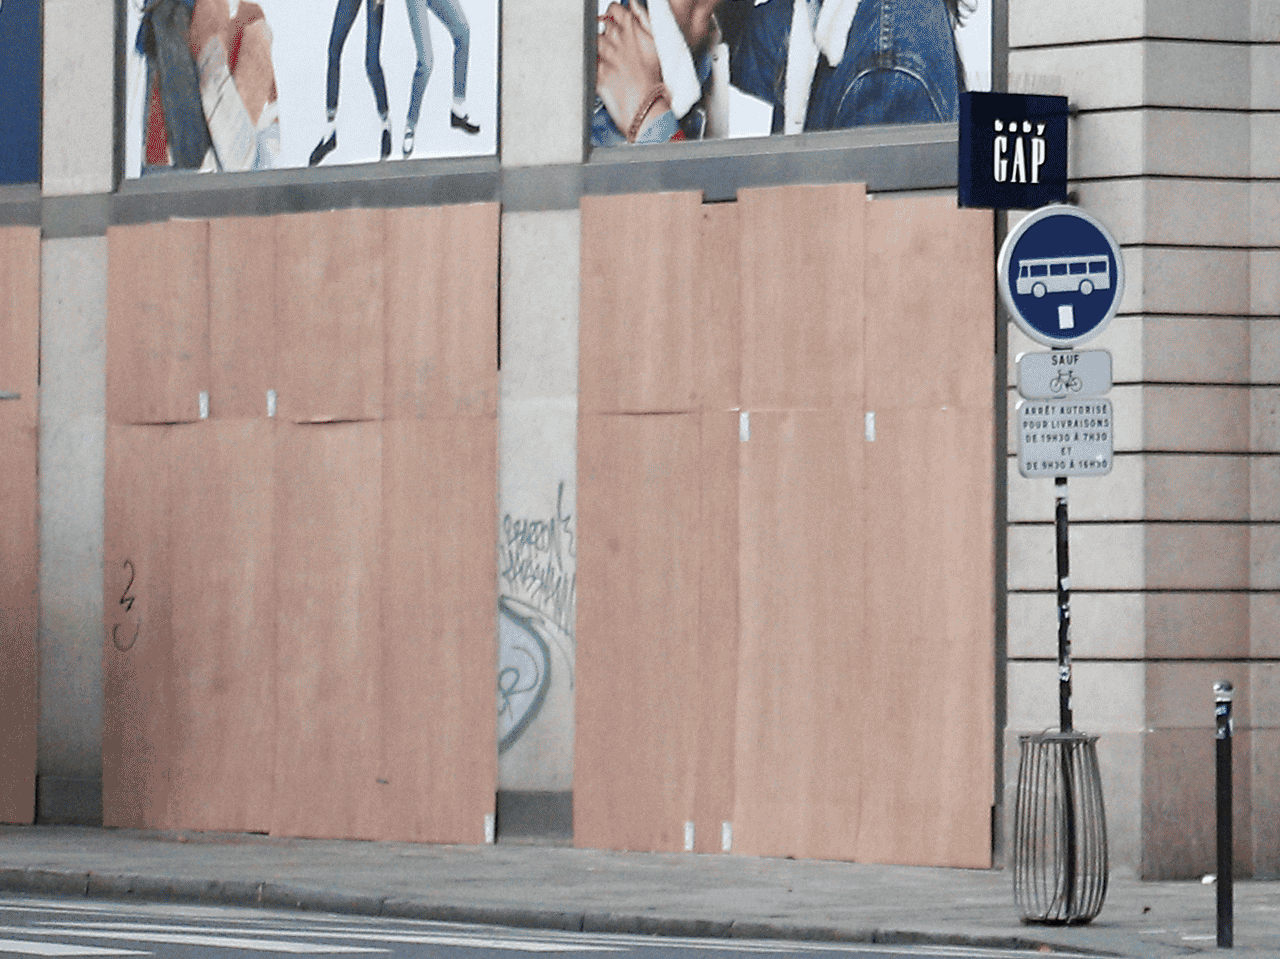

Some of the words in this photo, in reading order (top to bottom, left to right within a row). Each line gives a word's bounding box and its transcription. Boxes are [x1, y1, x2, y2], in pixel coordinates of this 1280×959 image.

[994, 118, 1046, 136] baby
[993, 135, 1046, 184] GAP
[1051, 354, 1080, 366] SAUF
[1025, 405, 1056, 415] ARRÊT
[1060, 404, 1107, 414] AUTORISÉ
[1023, 420, 1048, 429] POUR
[1051, 419, 1110, 429] LIVRAISONS
[1026, 434, 1037, 443] DE
[1041, 433, 1070, 443] 19H30
[1083, 432, 1108, 441] 7H30
[1060, 447, 1072, 456] ET
[1026, 461, 1038, 470] DE
[1042, 460, 1066, 470] 9H30
